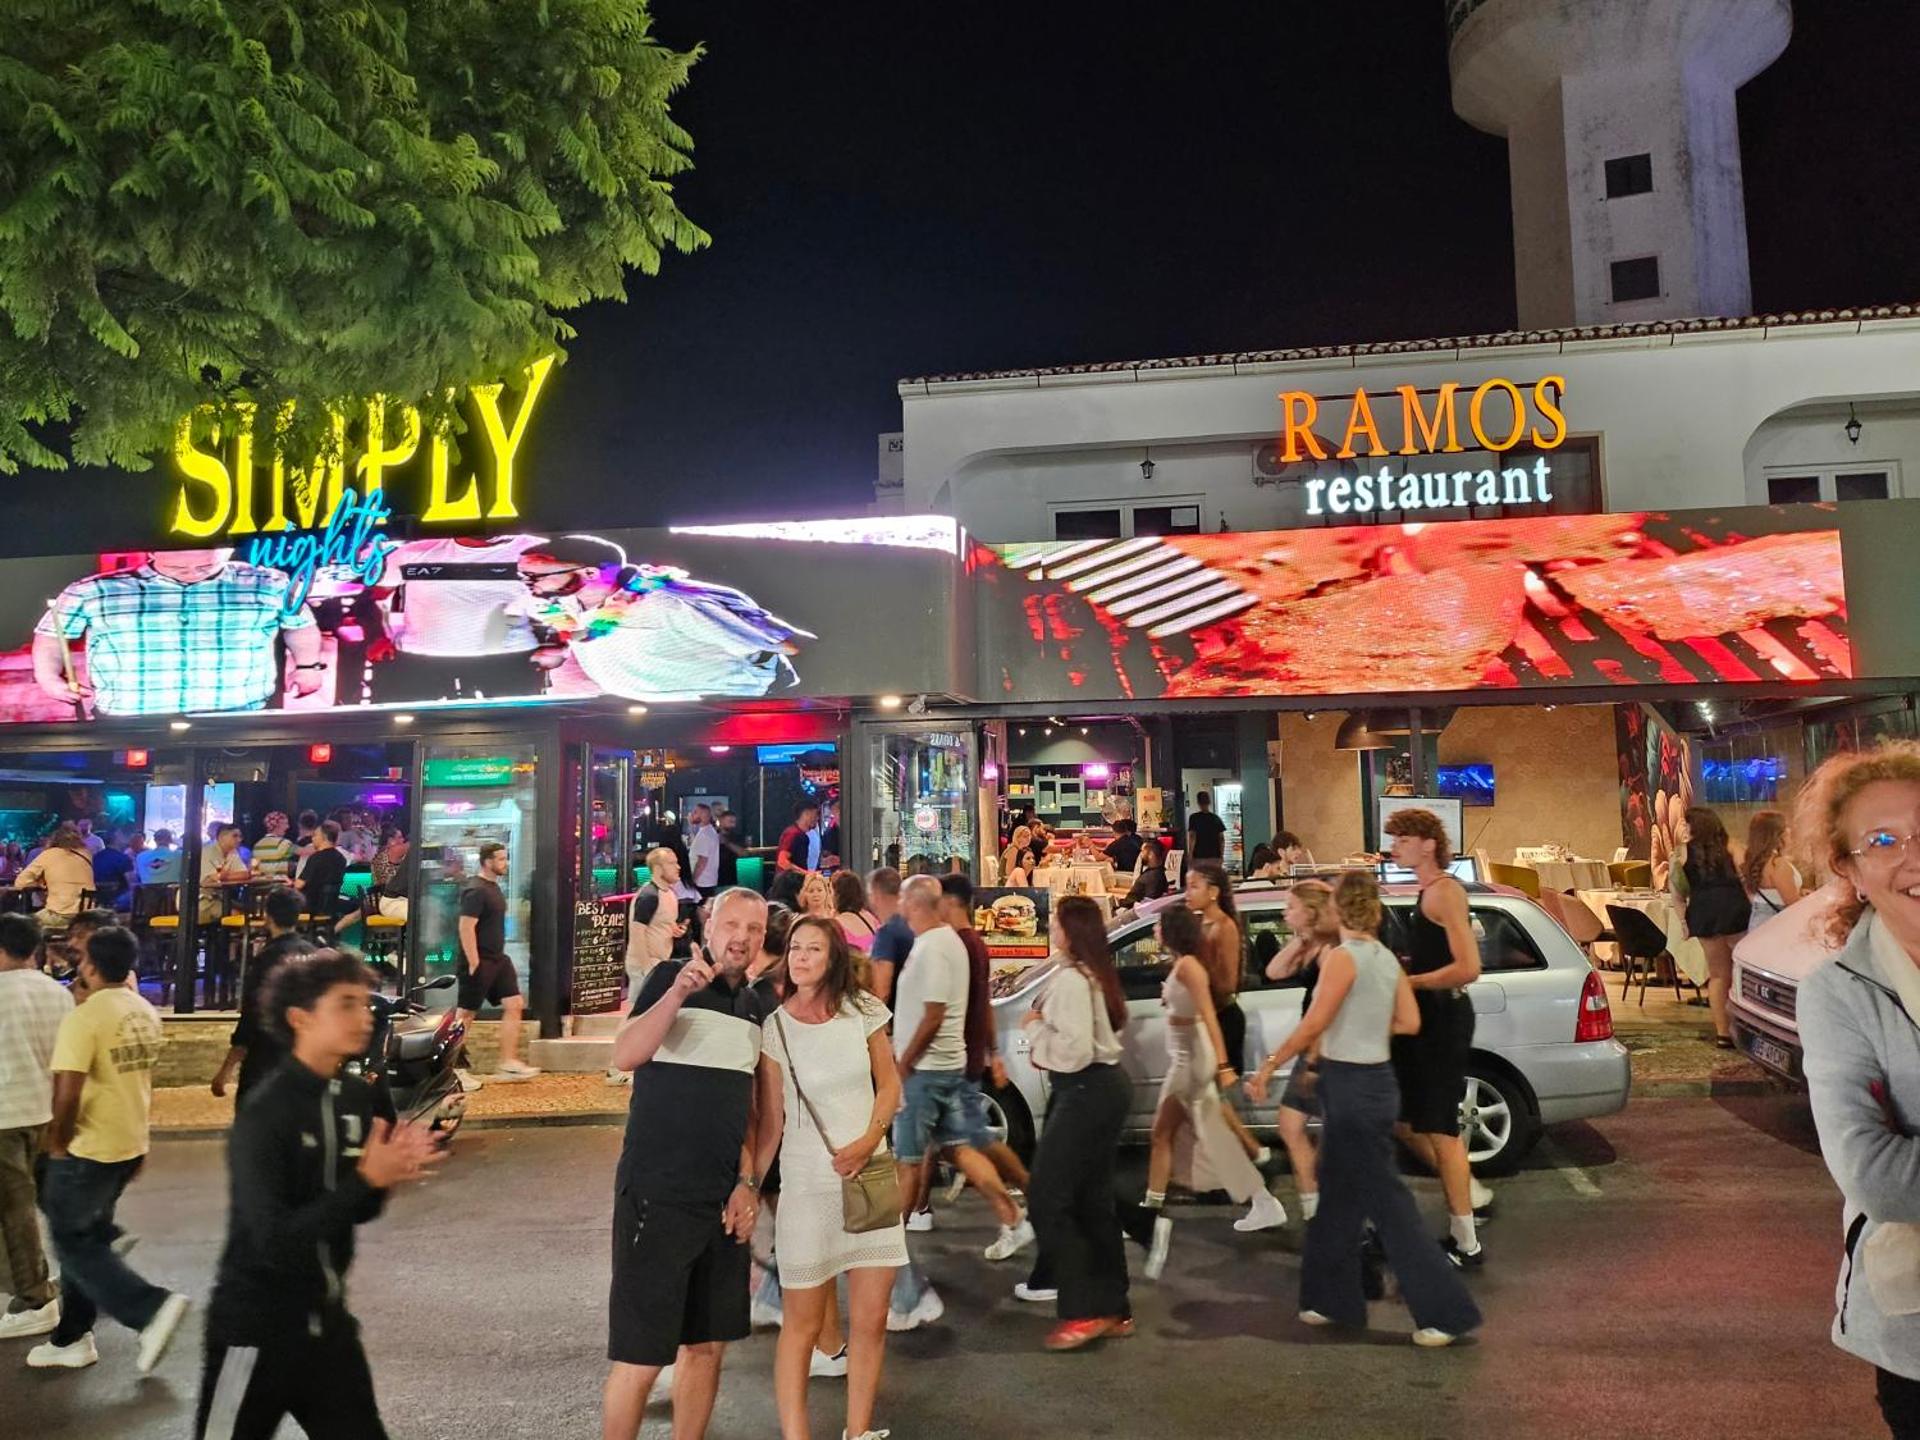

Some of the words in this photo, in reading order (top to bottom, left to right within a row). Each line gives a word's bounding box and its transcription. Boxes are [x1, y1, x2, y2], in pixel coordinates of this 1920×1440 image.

[169, 352, 556, 538] SIMPLY
[1278, 375, 1568, 463] RAMOS
[1304, 455, 1554, 516] restaurant
[249, 486, 398, 617] nights
[406, 566, 444, 576] EA7
[576, 900, 609, 915] BEST
[591, 913, 625, 929] DEALS
